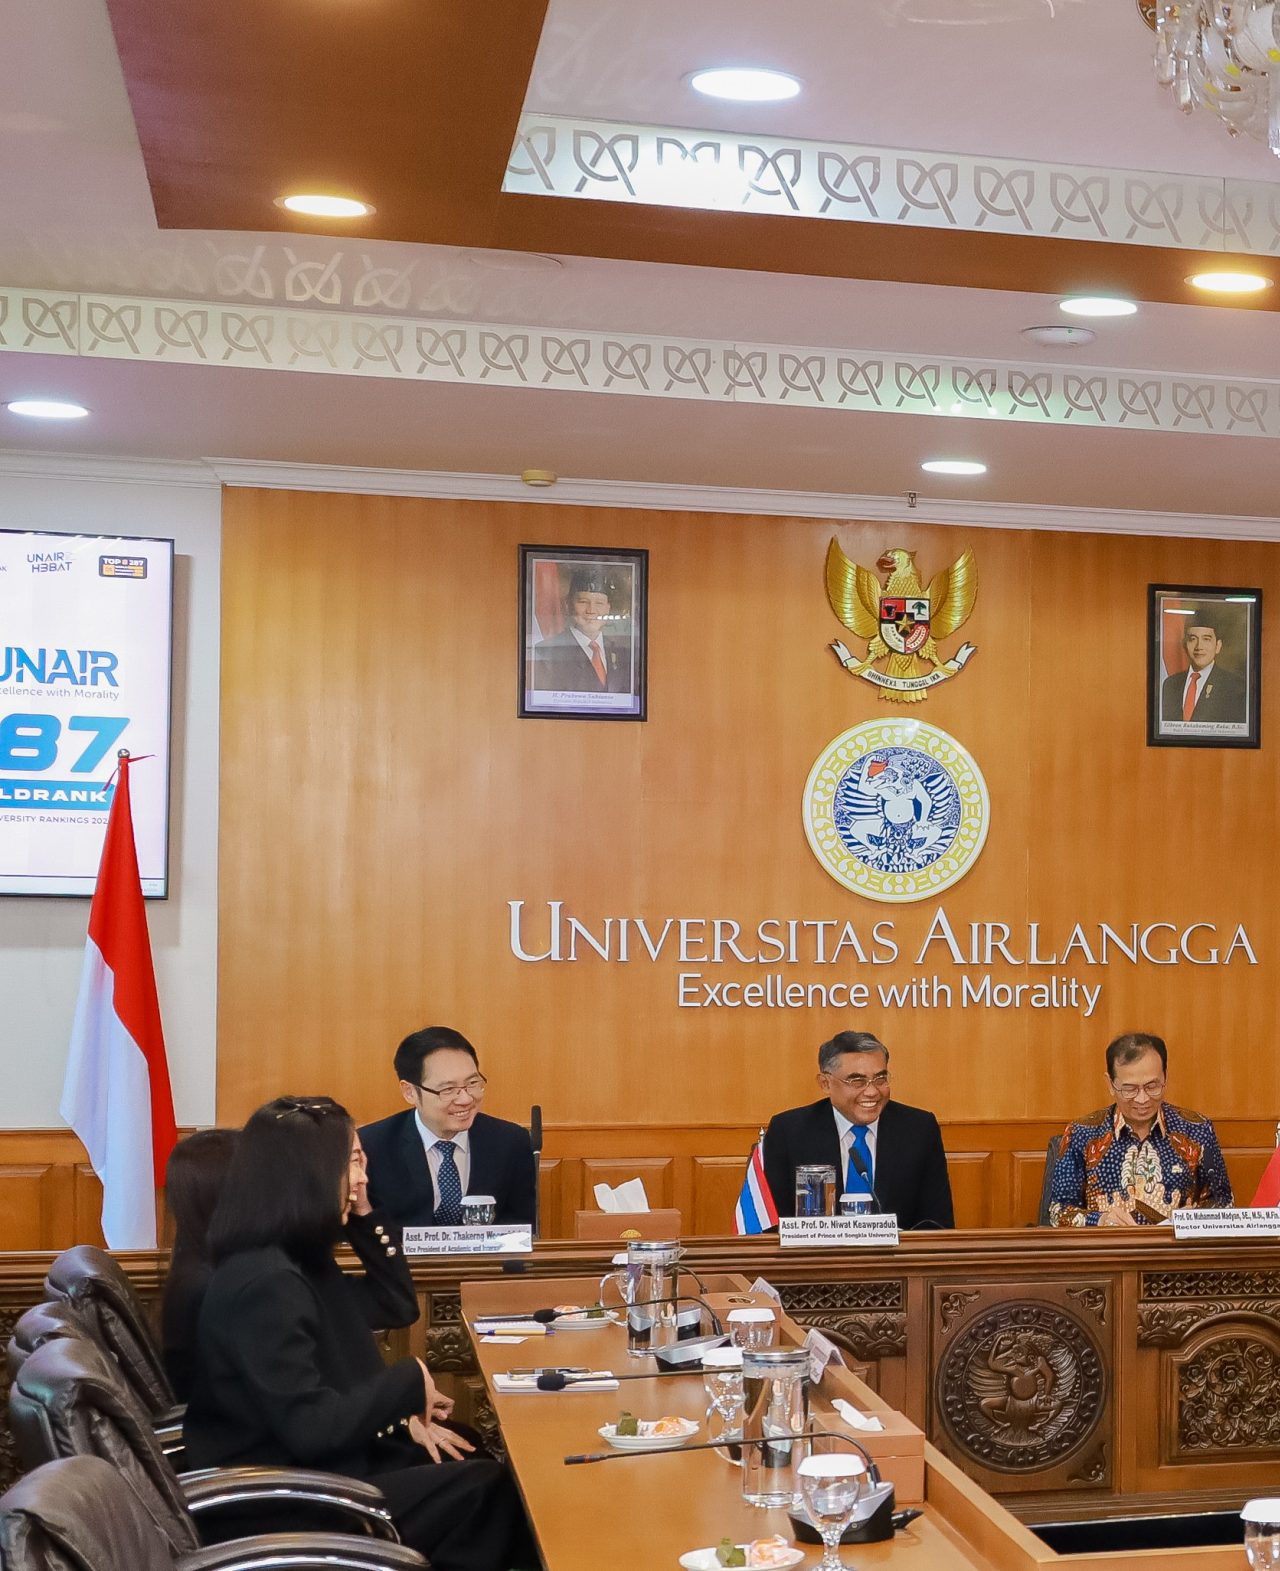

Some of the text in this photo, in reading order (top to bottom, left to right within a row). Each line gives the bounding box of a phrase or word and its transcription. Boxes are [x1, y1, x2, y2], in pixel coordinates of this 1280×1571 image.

[27, 552, 64, 563] UNAIR
[867, 671, 897, 687] BHINNEKA
[930, 672, 941, 683] IKA
[47, 688, 71, 697] with
[74, 689, 120, 701] Morality
[0, 713, 131, 773] 87
[0, 788, 108, 803] LDRANK
[40, 816, 89, 824] RANKINGS
[91, 817, 108, 825] 202
[507, 900, 1259, 965] UNIVERSITAS AIRLANGGA
[678, 973, 1102, 1017] Excellence with Morality
[1174, 1212, 1184, 1220] Prof.
[1193, 1212, 1220, 1220] Muhammad
[782, 1220, 896, 1230] Asst. Prof. Dr. Niwat Keawpradub
[405, 1231, 423, 1242] Asst.
[424, 1231, 440, 1241] Prof.
[441, 1231, 451, 1241] Dr.
[453, 1230, 485, 1243] Thakerng
